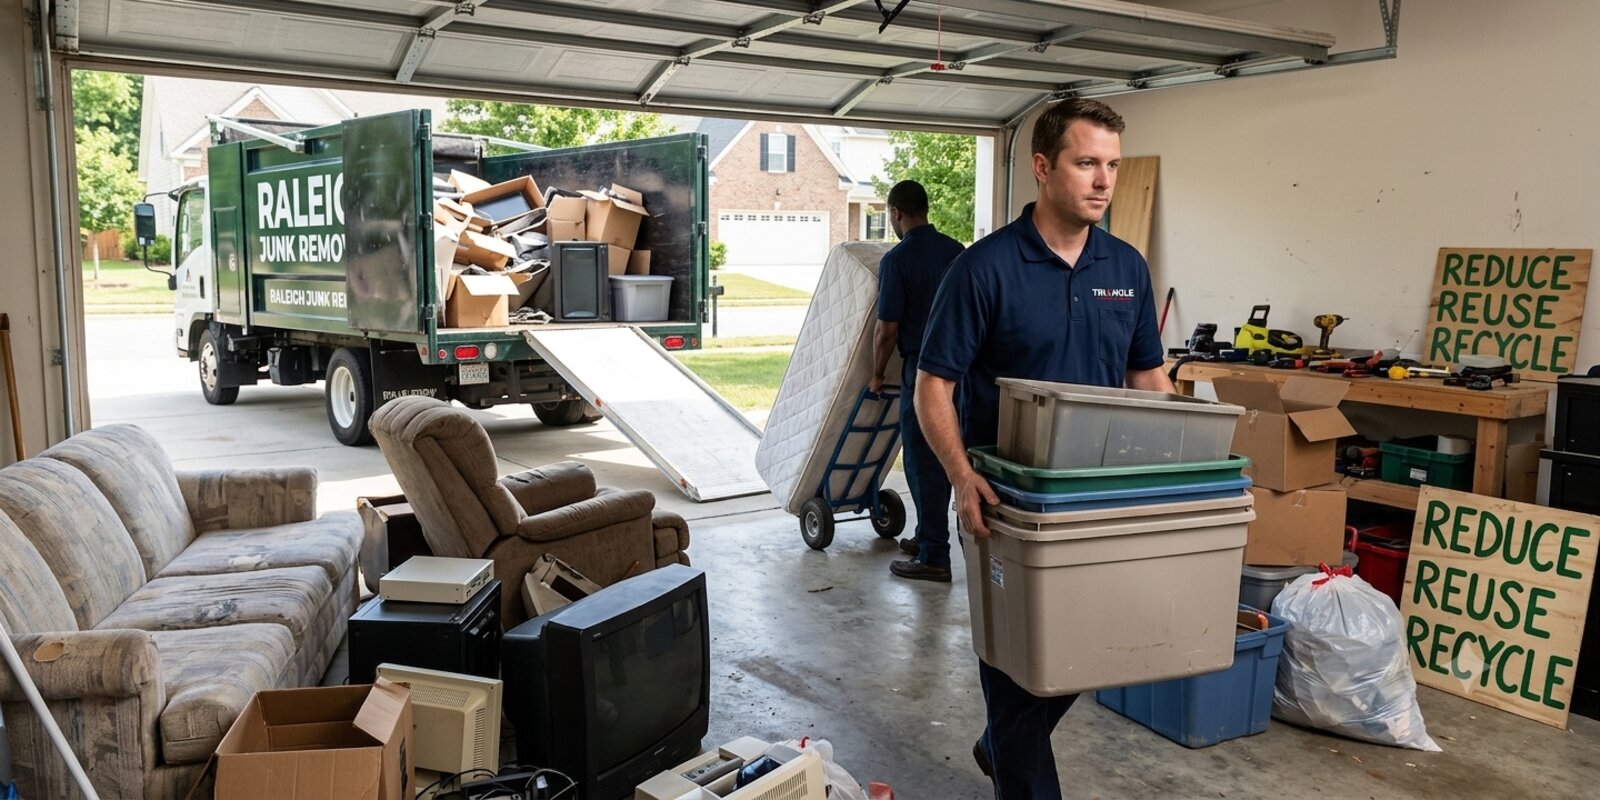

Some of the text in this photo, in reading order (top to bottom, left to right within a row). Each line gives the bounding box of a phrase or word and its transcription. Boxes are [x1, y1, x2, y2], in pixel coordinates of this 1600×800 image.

[260, 233, 346, 263] JUNK REMO
[1442, 253, 1575, 290] REDUCE
[270, 289, 305, 306] RALEIGH
[306, 290, 330, 307] JUNK
[1437, 290, 1560, 329] REUSE
[1430, 327, 1574, 374] RECYCLE
[1422, 500, 1591, 579] REDUCE
[1413, 559, 1556, 639] REUSE
[1407, 615, 1573, 710] RECYCLE
